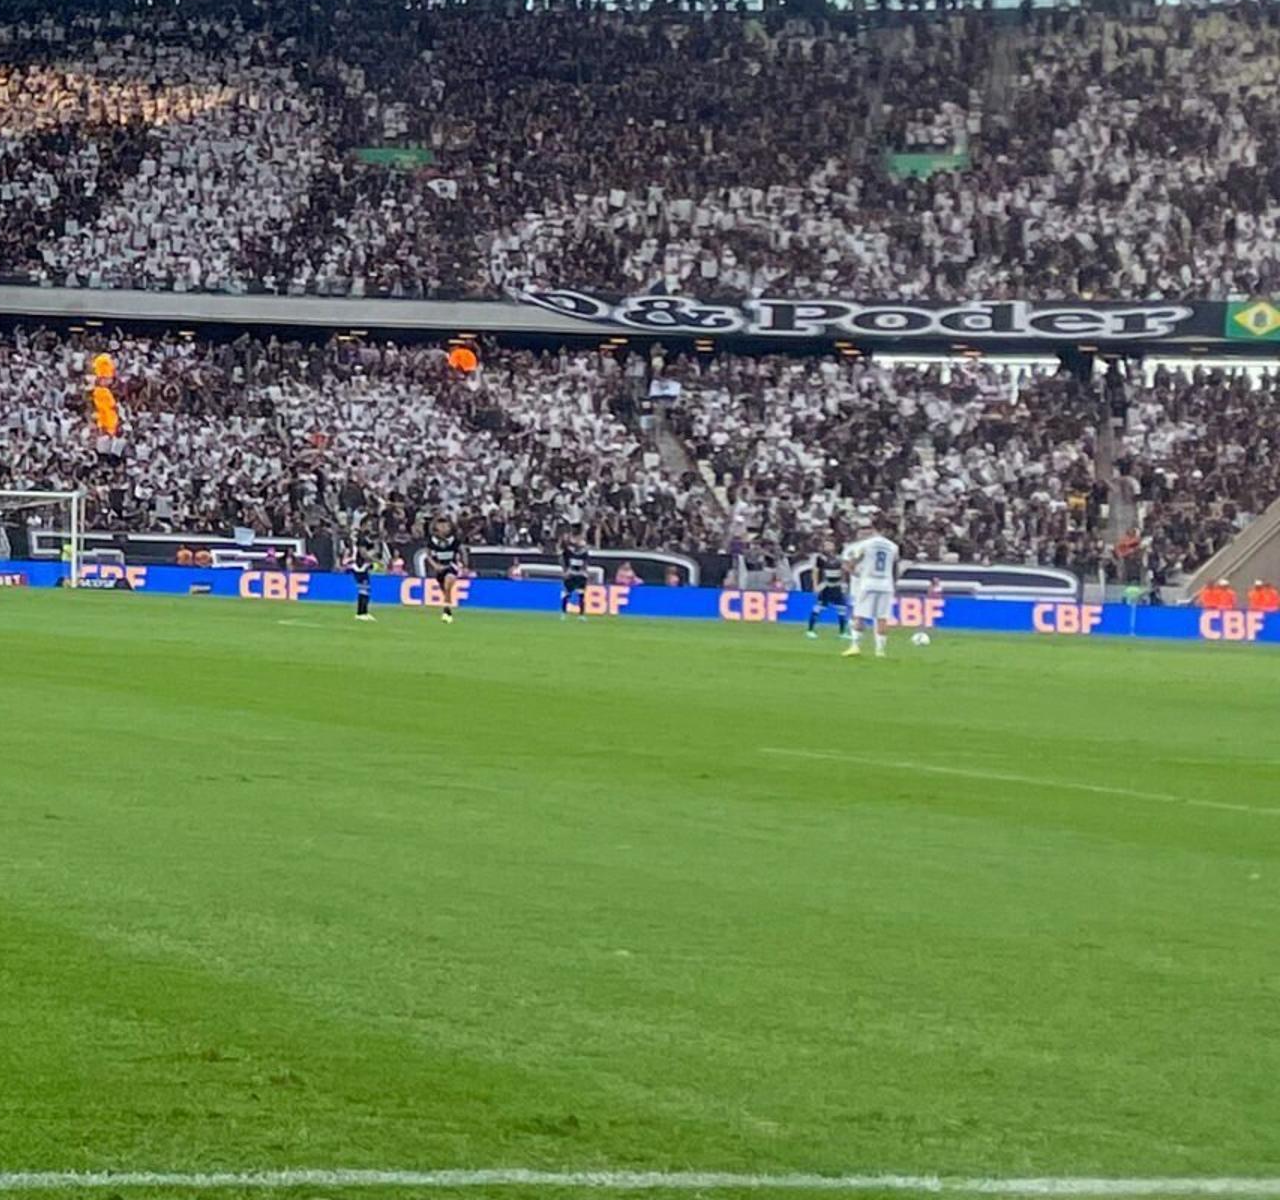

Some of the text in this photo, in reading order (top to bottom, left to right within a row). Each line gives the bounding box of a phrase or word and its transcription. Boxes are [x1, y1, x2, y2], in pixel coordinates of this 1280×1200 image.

[613, 295, 744, 333] &
[748, 299, 1194, 337] Poder
[874, 551, 887, 572] 8
[240, 571, 311, 601] CBF
[400, 577, 471, 607] CBF
[719, 591, 788, 622] CBF
[1032, 604, 1103, 634] CBF
[1199, 610, 1264, 641] CBF
